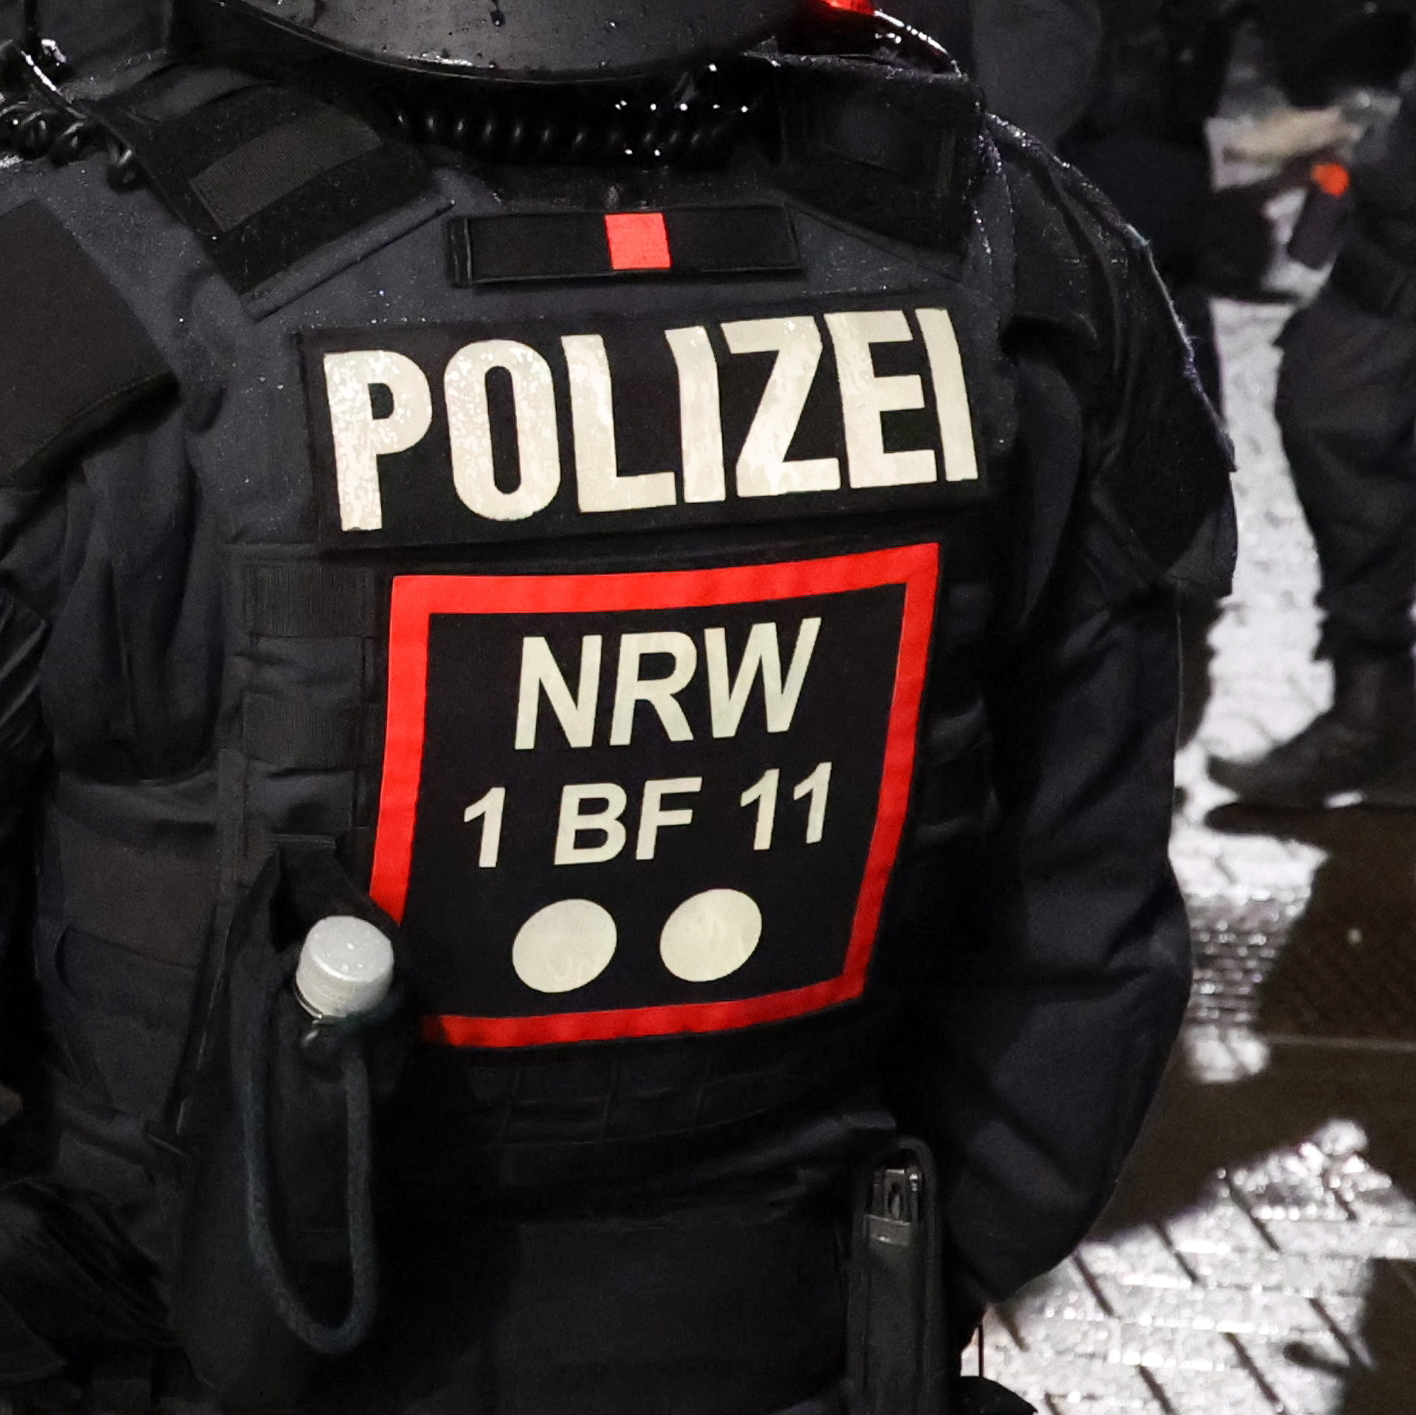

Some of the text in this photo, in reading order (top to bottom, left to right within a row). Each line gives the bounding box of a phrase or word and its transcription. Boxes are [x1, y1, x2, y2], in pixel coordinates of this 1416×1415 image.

[323, 307, 980, 532] POLIZEI
[514, 617, 823, 751] NRW
[463, 761, 833, 869] 1 BF 11
